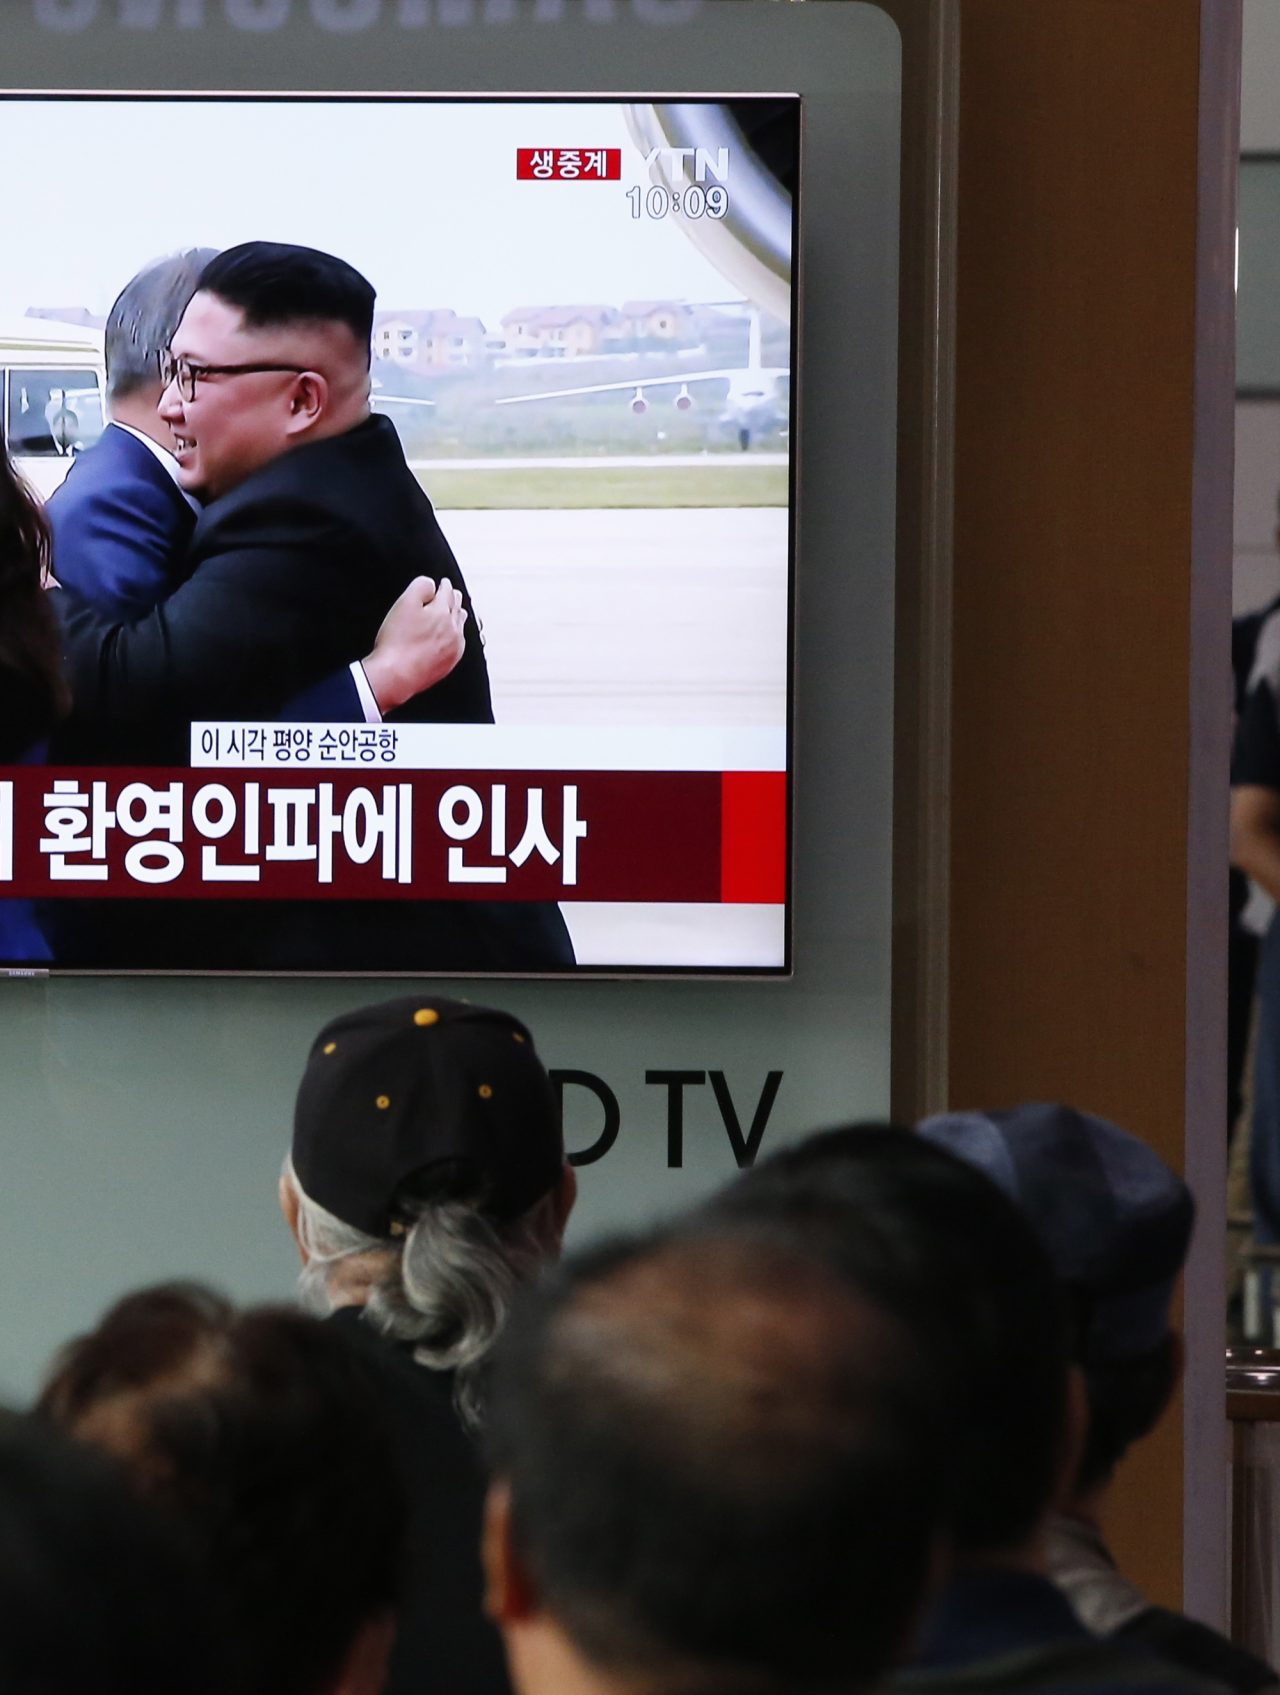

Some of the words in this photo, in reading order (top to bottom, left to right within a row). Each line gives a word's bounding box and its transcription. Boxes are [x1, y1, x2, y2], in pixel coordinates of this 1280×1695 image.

[530, 150, 608, 178] 생중계
[633, 147, 729, 181] YTN
[626, 185, 729, 219] 10:09
[201, 729, 220, 760] 이
[227, 729, 268, 761] 시각
[273, 729, 313, 762] 평양
[319, 730, 399, 763] 순안공항
[39, 780, 413, 884] 환영인파에
[438, 784, 587, 885] 인사
[645, 1070, 784, 1168] TV
